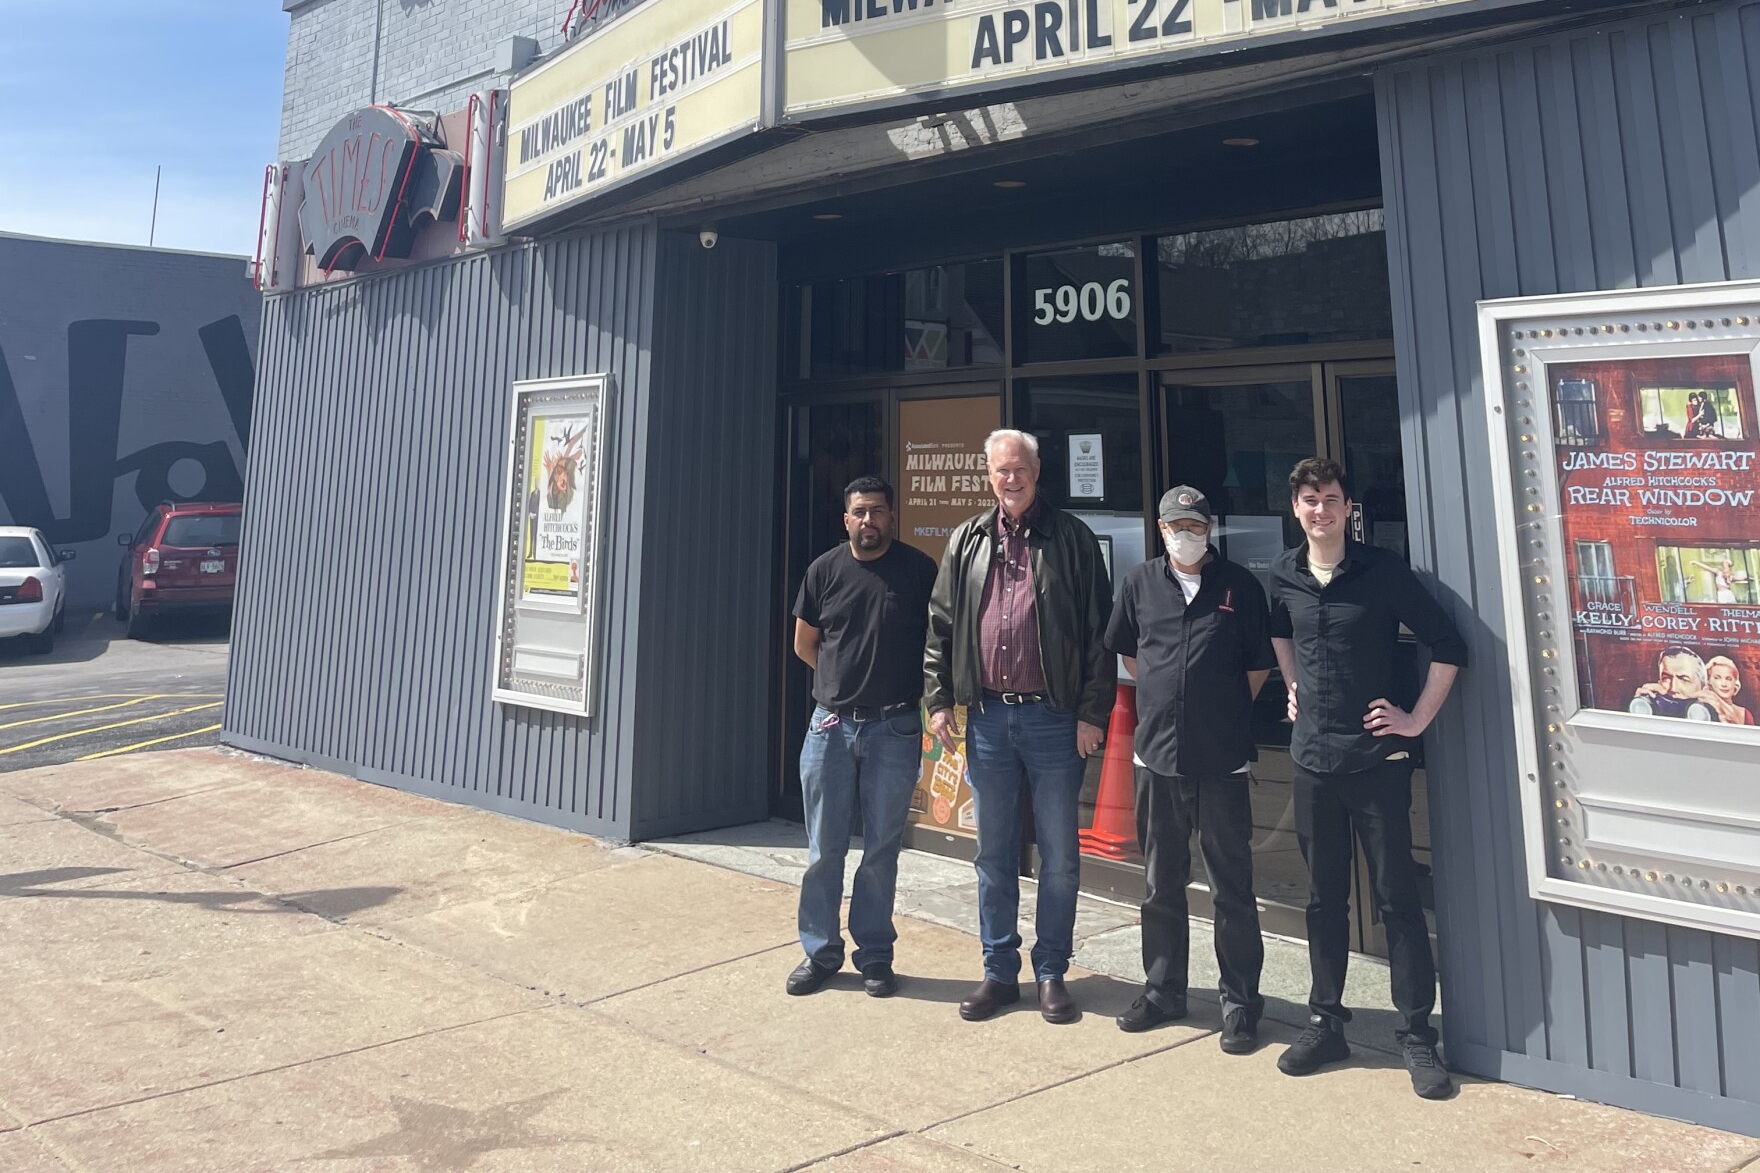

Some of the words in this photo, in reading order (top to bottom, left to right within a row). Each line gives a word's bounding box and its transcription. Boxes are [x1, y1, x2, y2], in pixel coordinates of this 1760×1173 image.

[520, 94, 592, 165] MILWAUKEE
[604, 69, 638, 126] FILM
[650, 20, 732, 101] FESTIVAL
[349, 115, 362, 131] THE
[543, 158, 583, 202] APRIL
[621, 112, 661, 169] MAY
[664, 106, 676, 151] 5
[311, 132, 394, 225] TIMES
[333, 215, 360, 235] CINEMA
[1034, 278, 1131, 325] 5906
[906, 453, 987, 471] MILWAUKE
[1562, 451, 1637, 471] JAMES
[1643, 450, 1756, 472] STEWART
[911, 475, 946, 492] FILM
[951, 475, 990, 492] FEST
[1603, 476, 1645, 486] ALFRED
[1648, 476, 1716, 487] HITCHCOCK'S
[908, 498, 927, 506] APRIL
[929, 498, 936, 506] 21
[951, 498, 965, 506] MAY
[968, 498, 972, 506] 5
[978, 498, 995, 506] 2022
[1568, 486, 1632, 507] REAR
[1638, 488, 1755, 507] WINDOW
[1353, 510, 1361, 542] PUL
[1628, 515, 1698, 526] TECHNICOLOR
[1587, 601, 1622, 612] GRACE
[1643, 605, 1697, 616] WENDELL
[1576, 610, 1634, 627] KELLY
[1642, 615, 1701, 631] COREY
